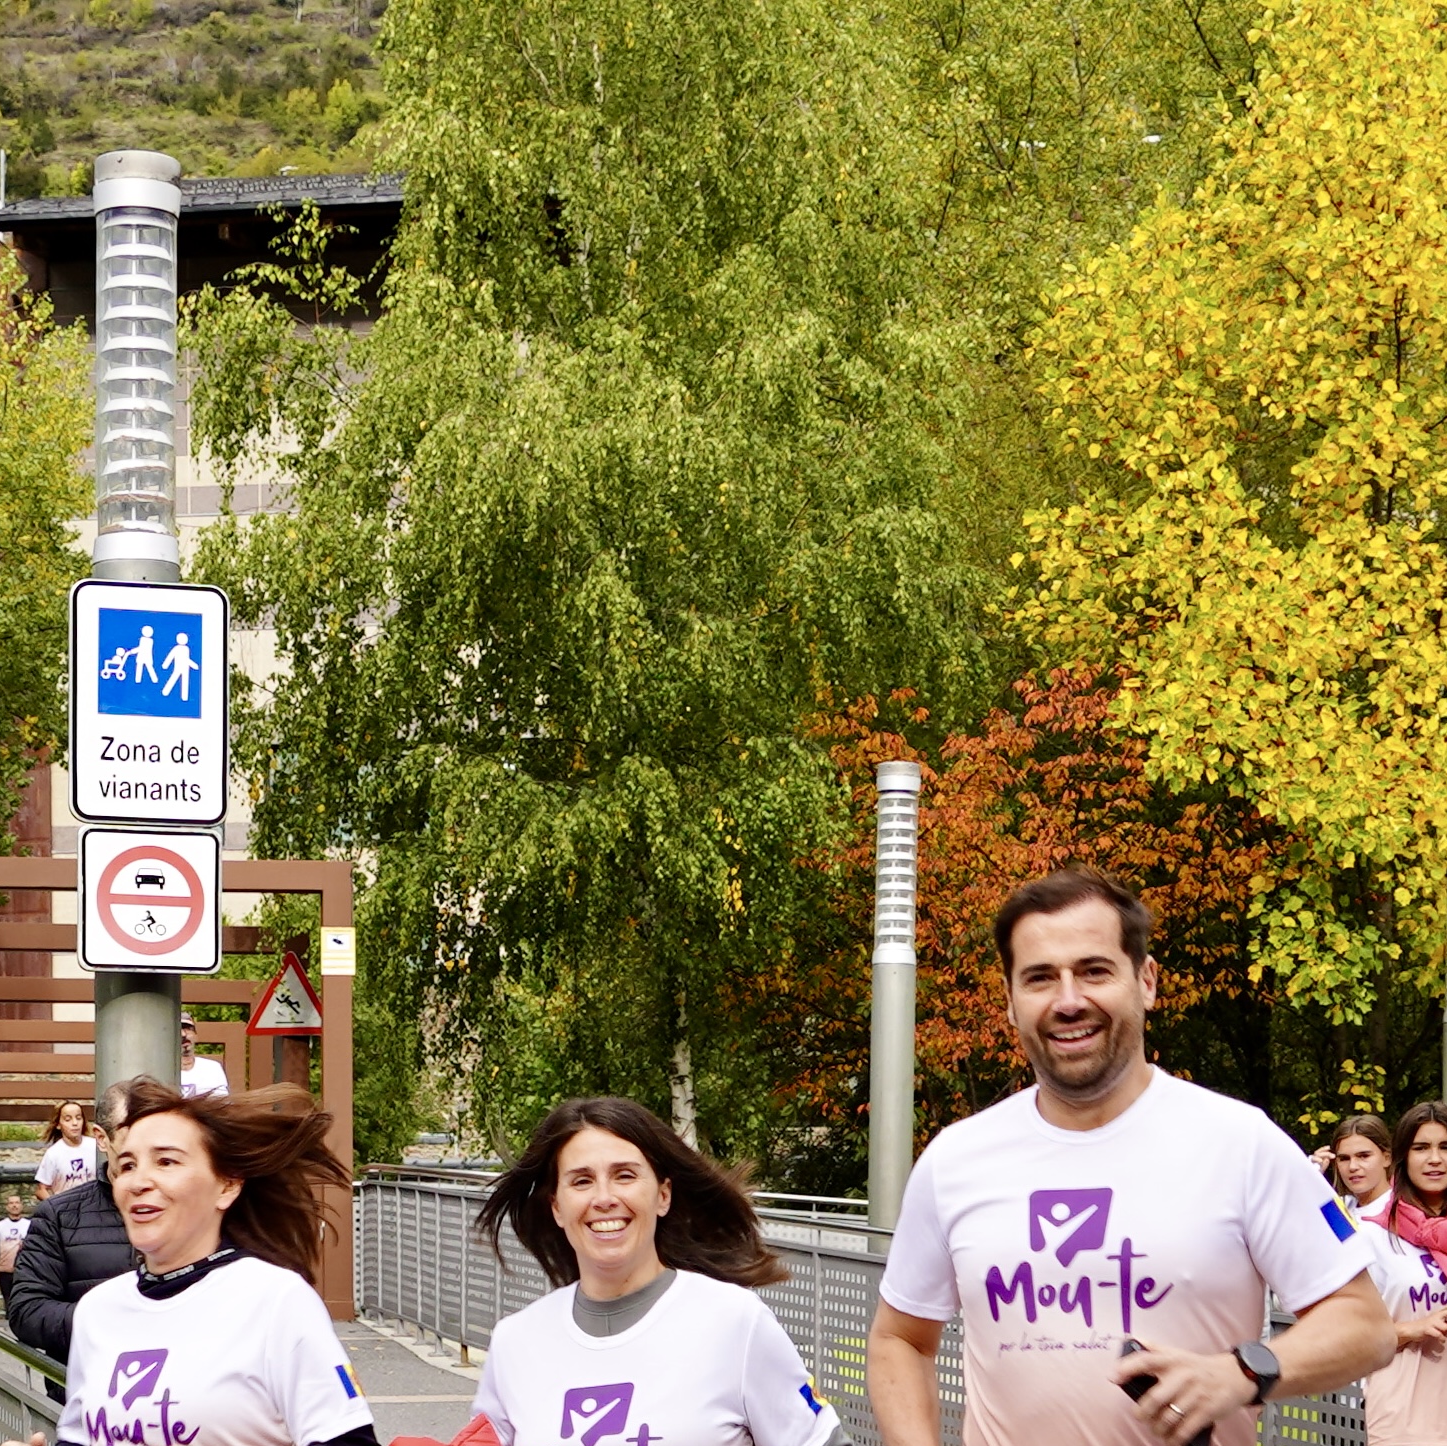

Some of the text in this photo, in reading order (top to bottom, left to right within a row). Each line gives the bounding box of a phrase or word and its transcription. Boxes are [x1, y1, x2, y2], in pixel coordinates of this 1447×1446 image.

[100, 736, 200, 765] Zona de
[98, 774, 202, 802] vianants
[985, 1237, 1174, 1334] Mou-te
